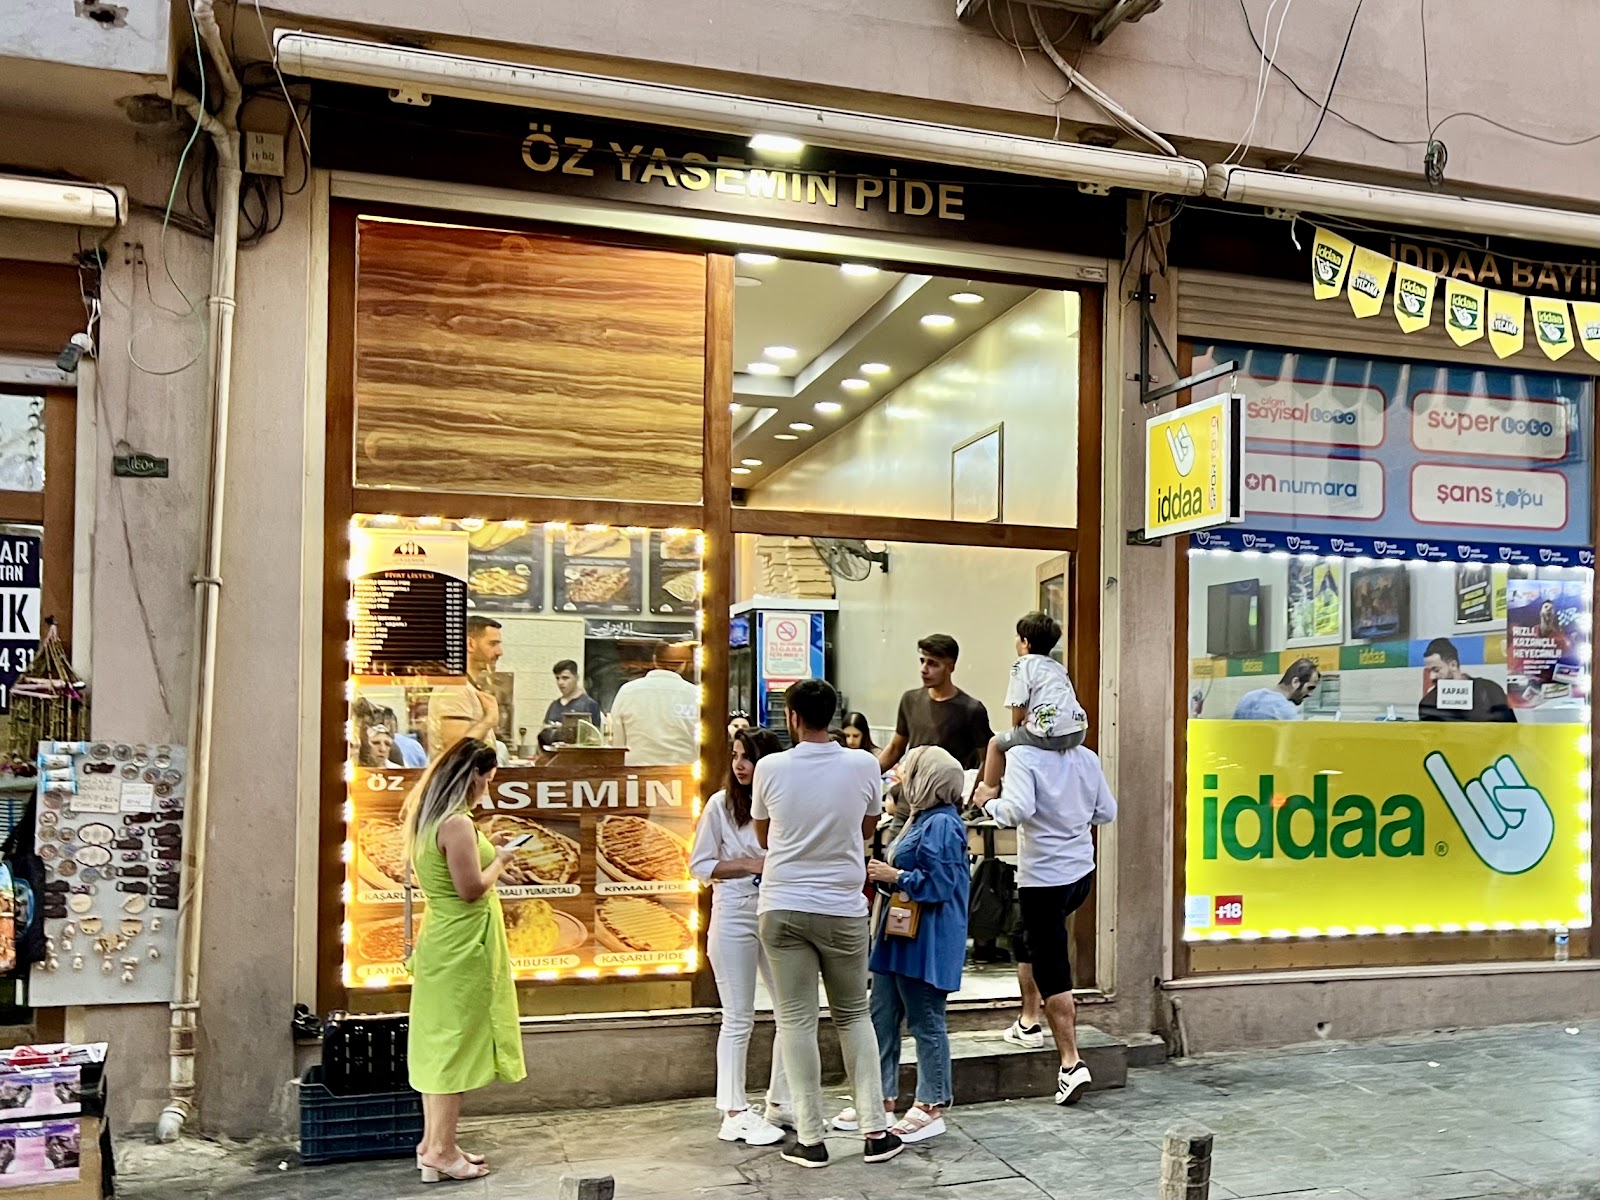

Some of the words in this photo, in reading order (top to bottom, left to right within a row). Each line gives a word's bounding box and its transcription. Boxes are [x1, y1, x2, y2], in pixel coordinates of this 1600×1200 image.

[522, 123, 594, 176] ÖZ
[855, 168, 965, 220] PİDE
[1317, 244, 1342, 266] iddaa
[1389, 236, 1502, 285] İDDAA
[1401, 279, 1426, 298] iddaa
[1452, 294, 1477, 310] iddaa
[1539, 310, 1562, 324] iddaa
[1427, 410, 1500, 435] süper
[1279, 479, 1358, 497] numara
[1436, 483, 1493, 505] şans
[1157, 483, 1203, 523] iddaa
[366, 773, 405, 791] ÖZ
[1202, 774, 1425, 860] iddaa
[364, 891, 406, 901] KAŞARL
[524, 886, 575, 896] YUMURTALI
[604, 884, 653, 893] KIYMALI
[1215, 902, 1242, 919] +18
[602, 953, 653, 964] KAŞARLI
[657, 952, 685, 960] PİDE
